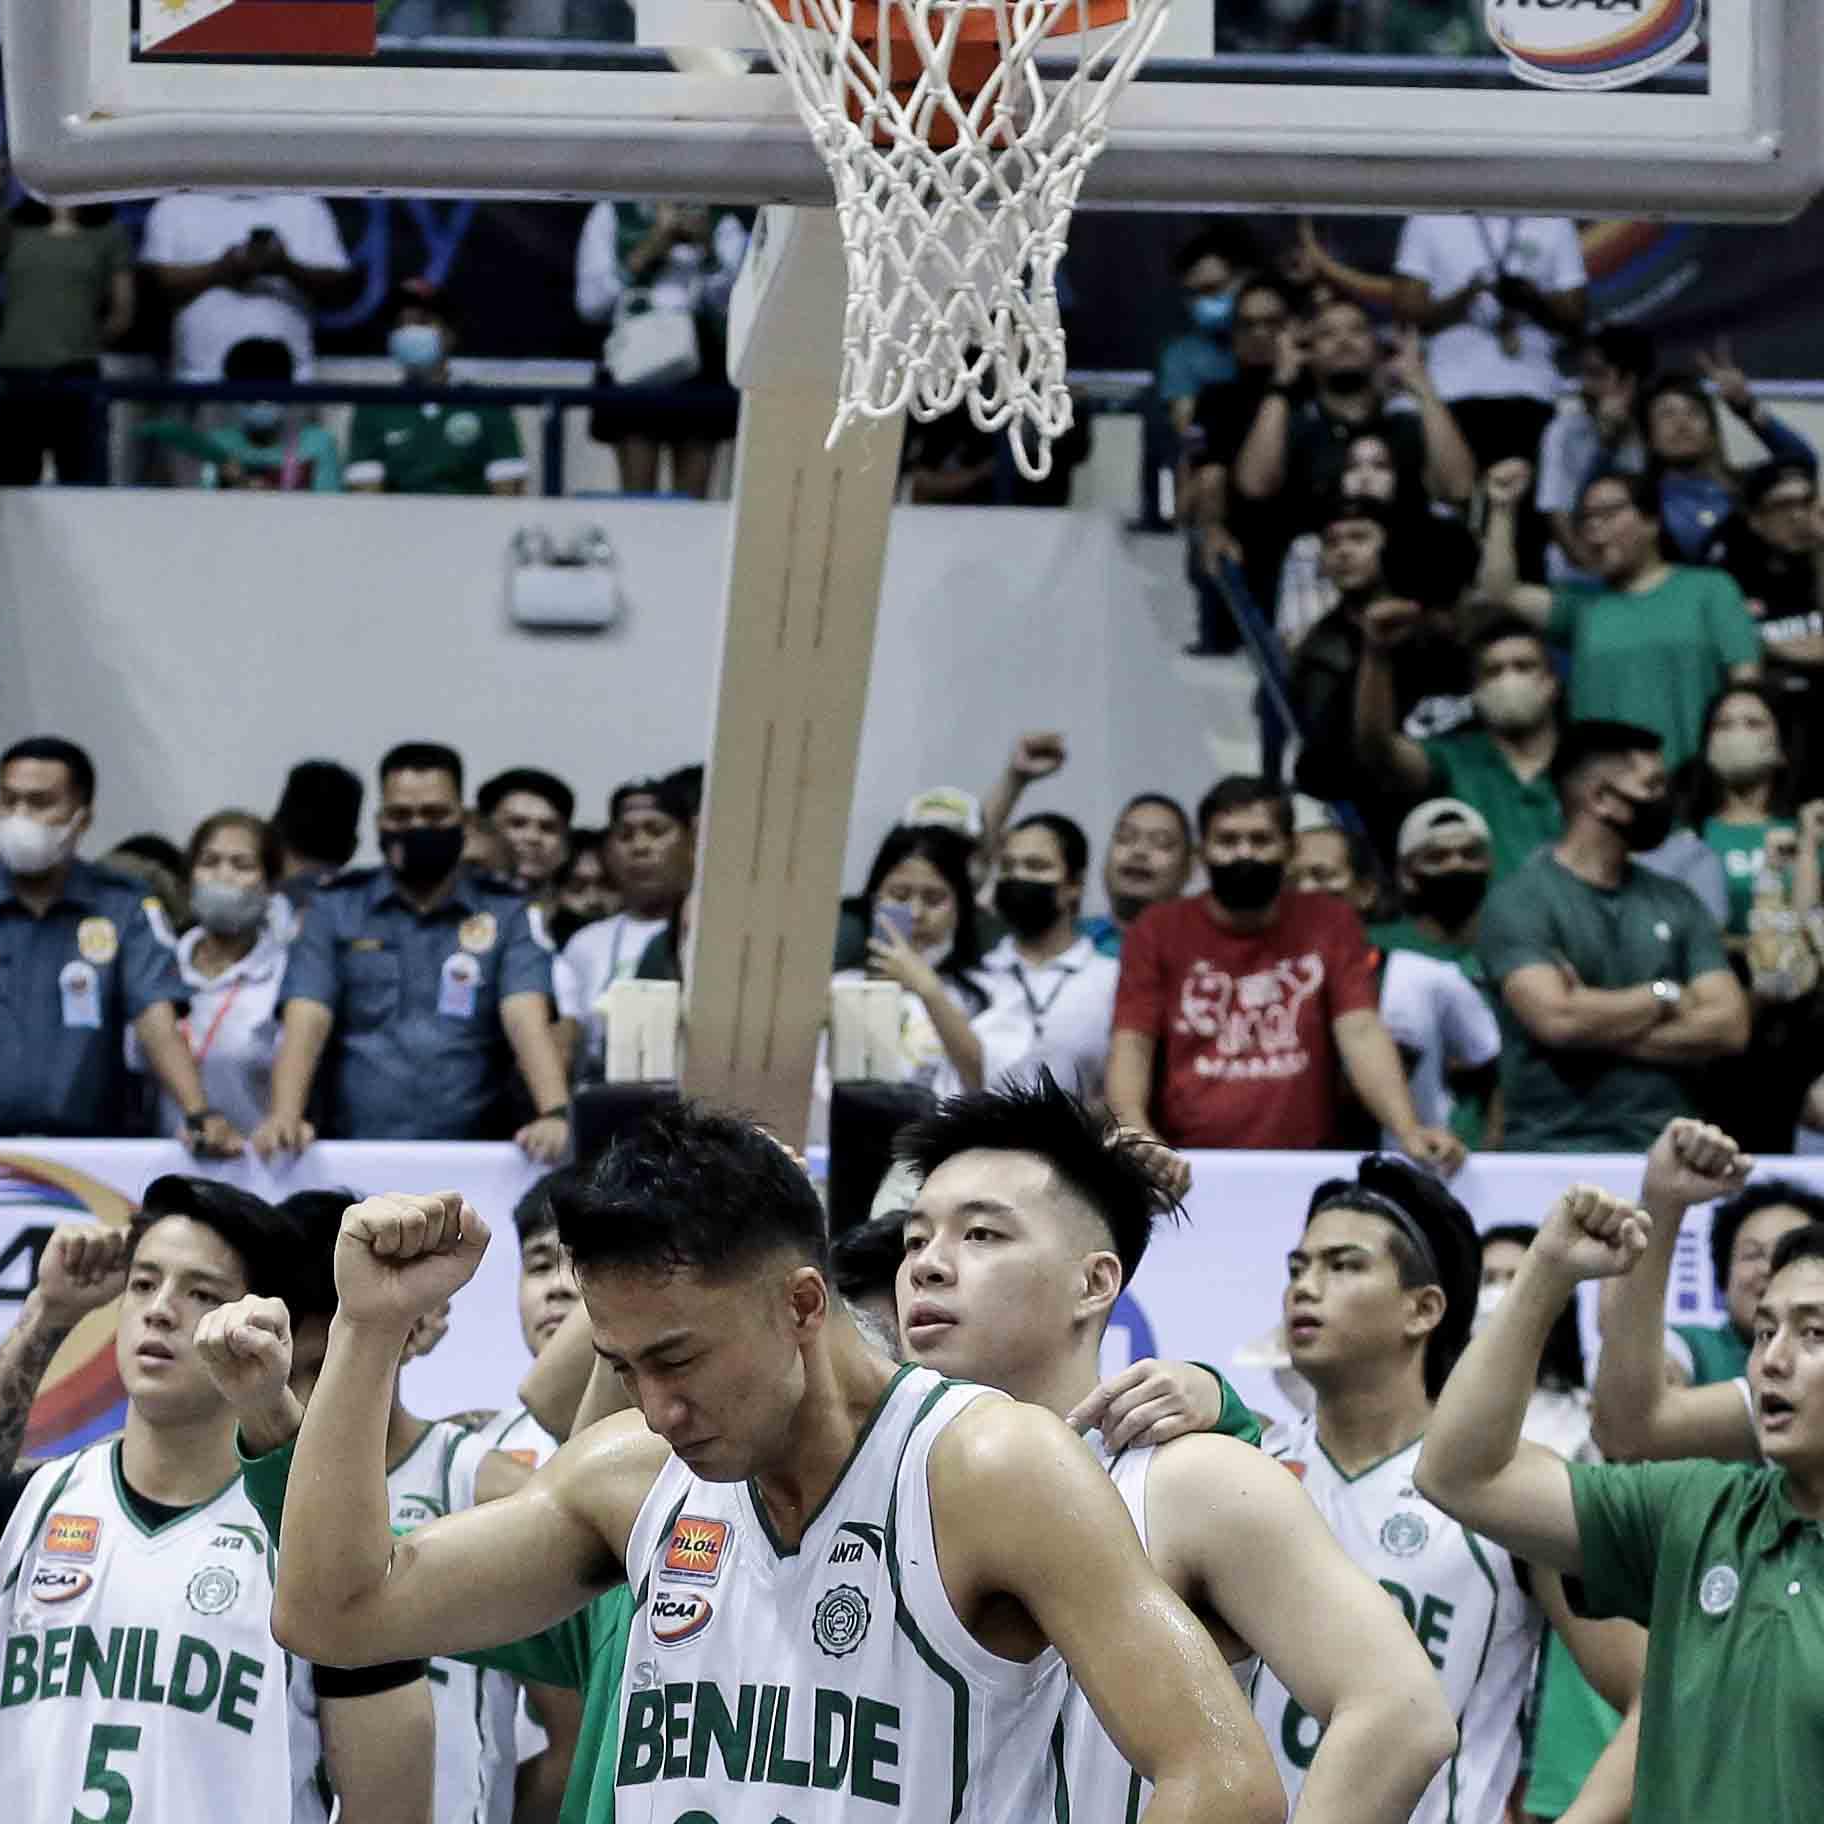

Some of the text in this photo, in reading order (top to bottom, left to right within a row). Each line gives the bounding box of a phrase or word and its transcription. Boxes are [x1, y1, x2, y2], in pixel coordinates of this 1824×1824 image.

[828, 1541, 865, 1564] ANTA
[32, 1575, 77, 1586] NCAA
[651, 1601, 698, 1618] NCAA
[0, 1625, 264, 1735] BENILDE
[615, 1680, 901, 1807] BENILDE
